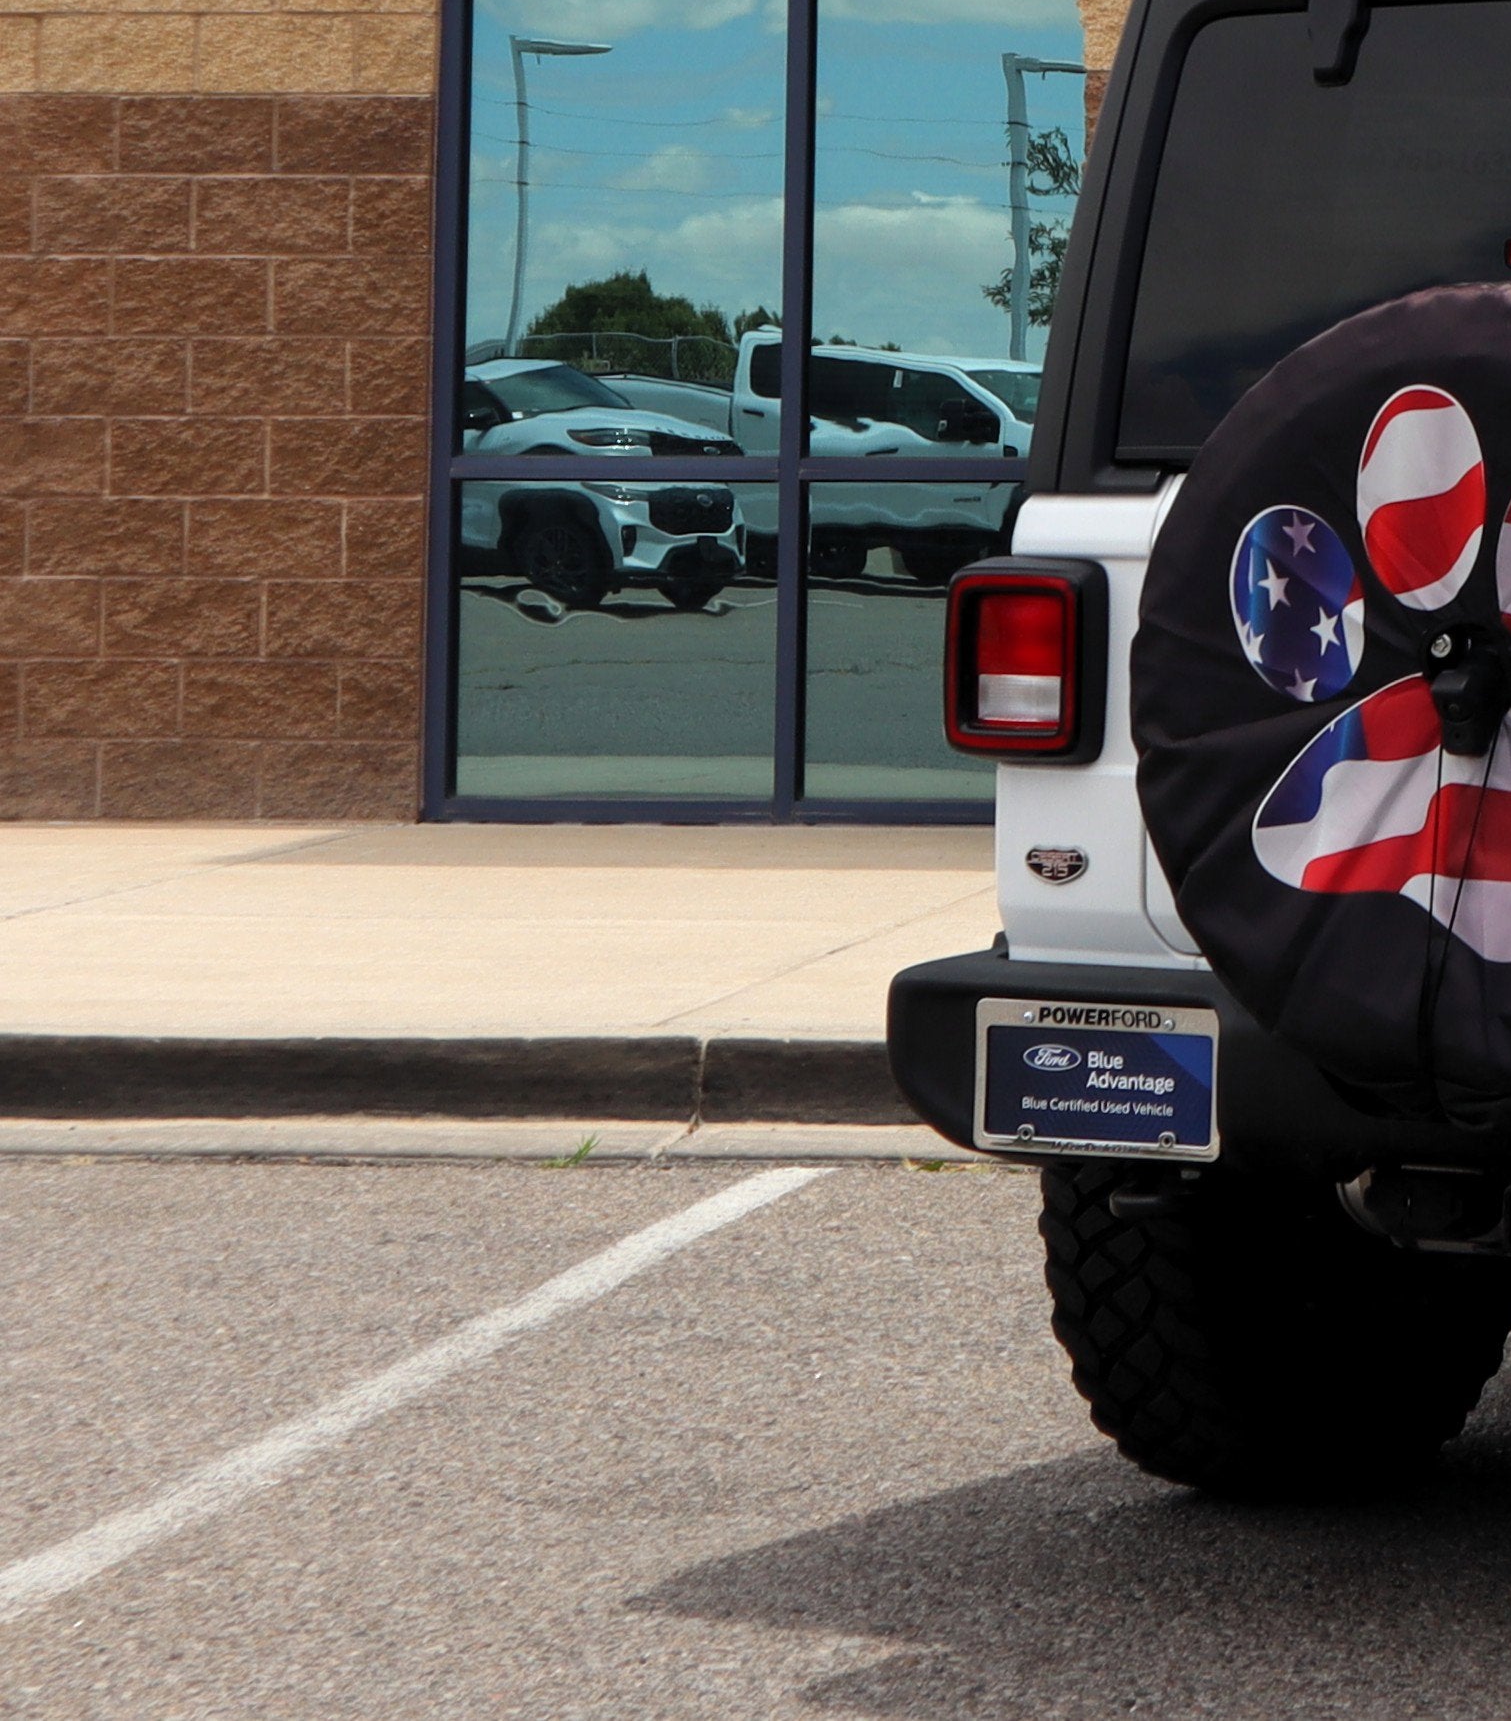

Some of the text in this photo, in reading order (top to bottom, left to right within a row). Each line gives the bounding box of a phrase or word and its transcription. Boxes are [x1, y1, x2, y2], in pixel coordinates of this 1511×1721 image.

[1038, 1005, 1162, 1028] POWERFORD
[1034, 1046, 1072, 1067] Ford
[1087, 1050, 1124, 1069] Blue
[1086, 1071, 1175, 1095] Advantage
[1021, 1096, 1174, 1116] Blue Certified Used Vehicle
